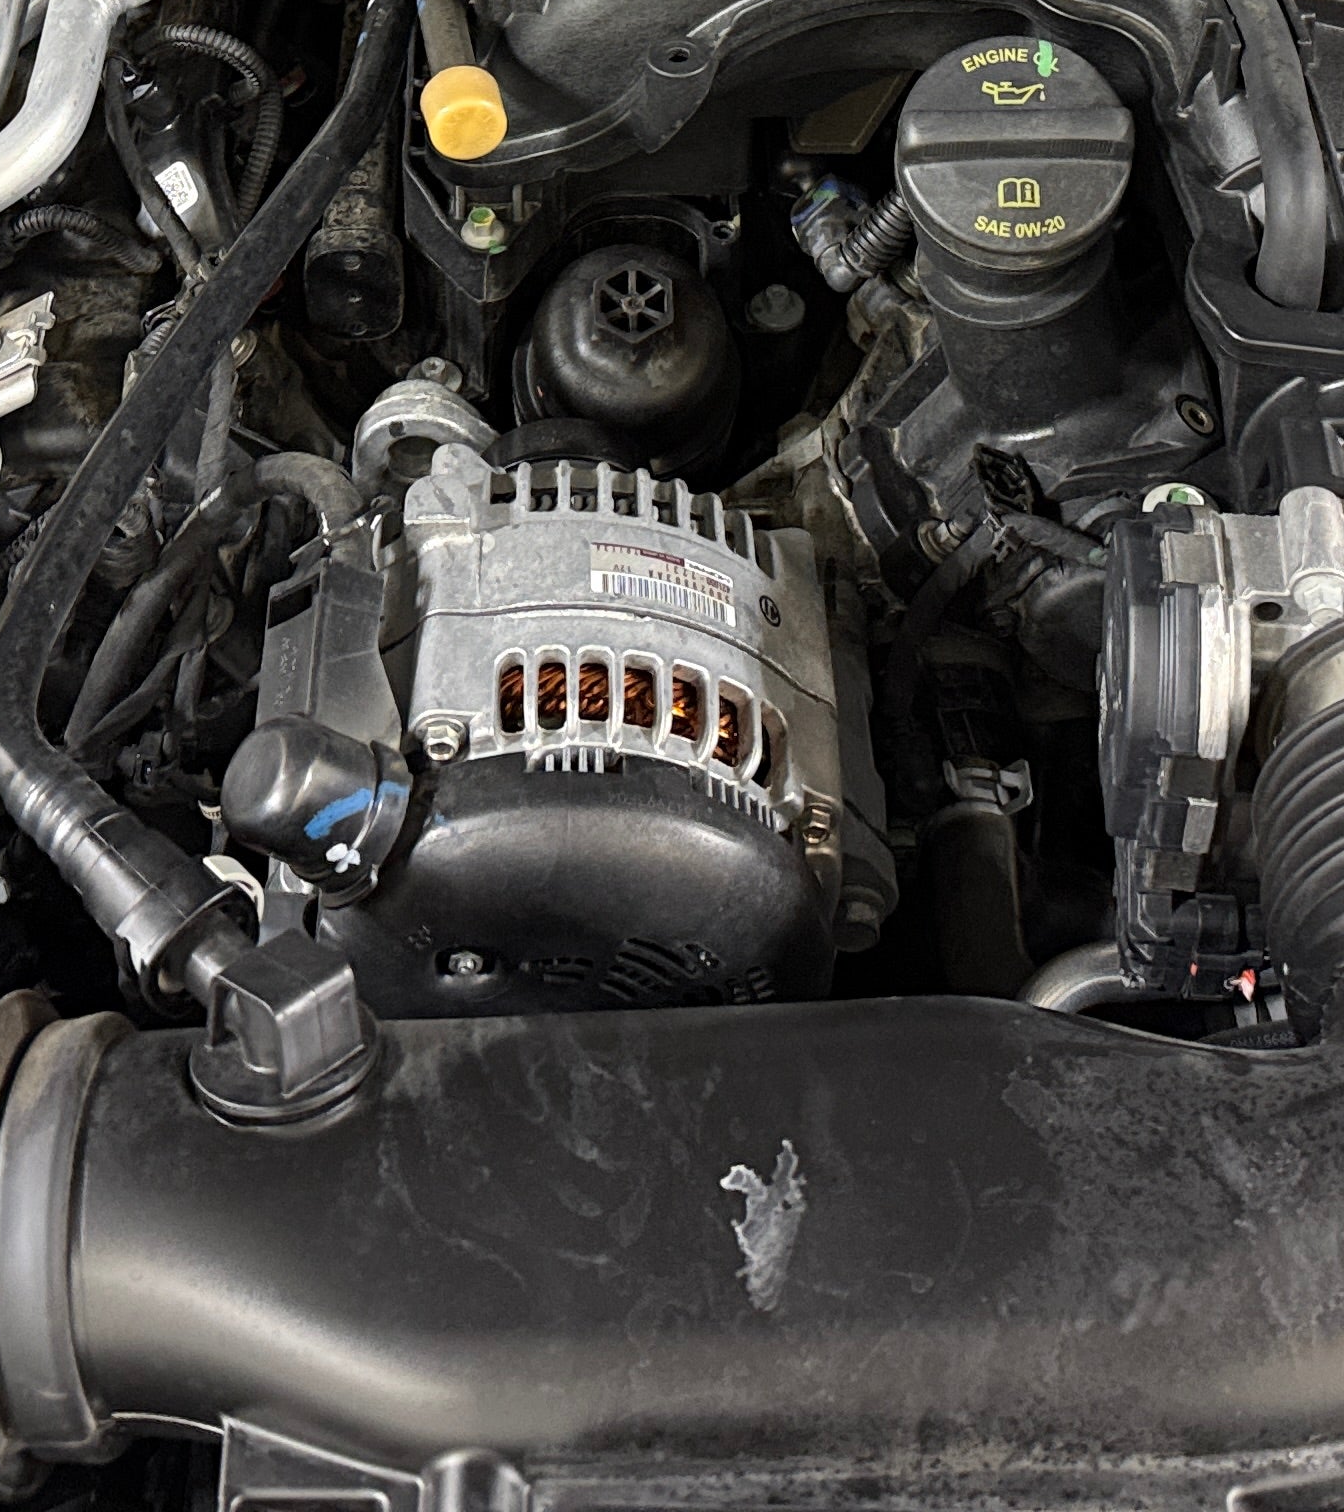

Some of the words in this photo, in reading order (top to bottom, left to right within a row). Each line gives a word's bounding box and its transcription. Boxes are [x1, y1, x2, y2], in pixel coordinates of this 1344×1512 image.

[961, 48, 1029, 73] ENGINE
[974, 216, 1010, 238] SAE
[1015, 215, 1066, 239] 0W-20
